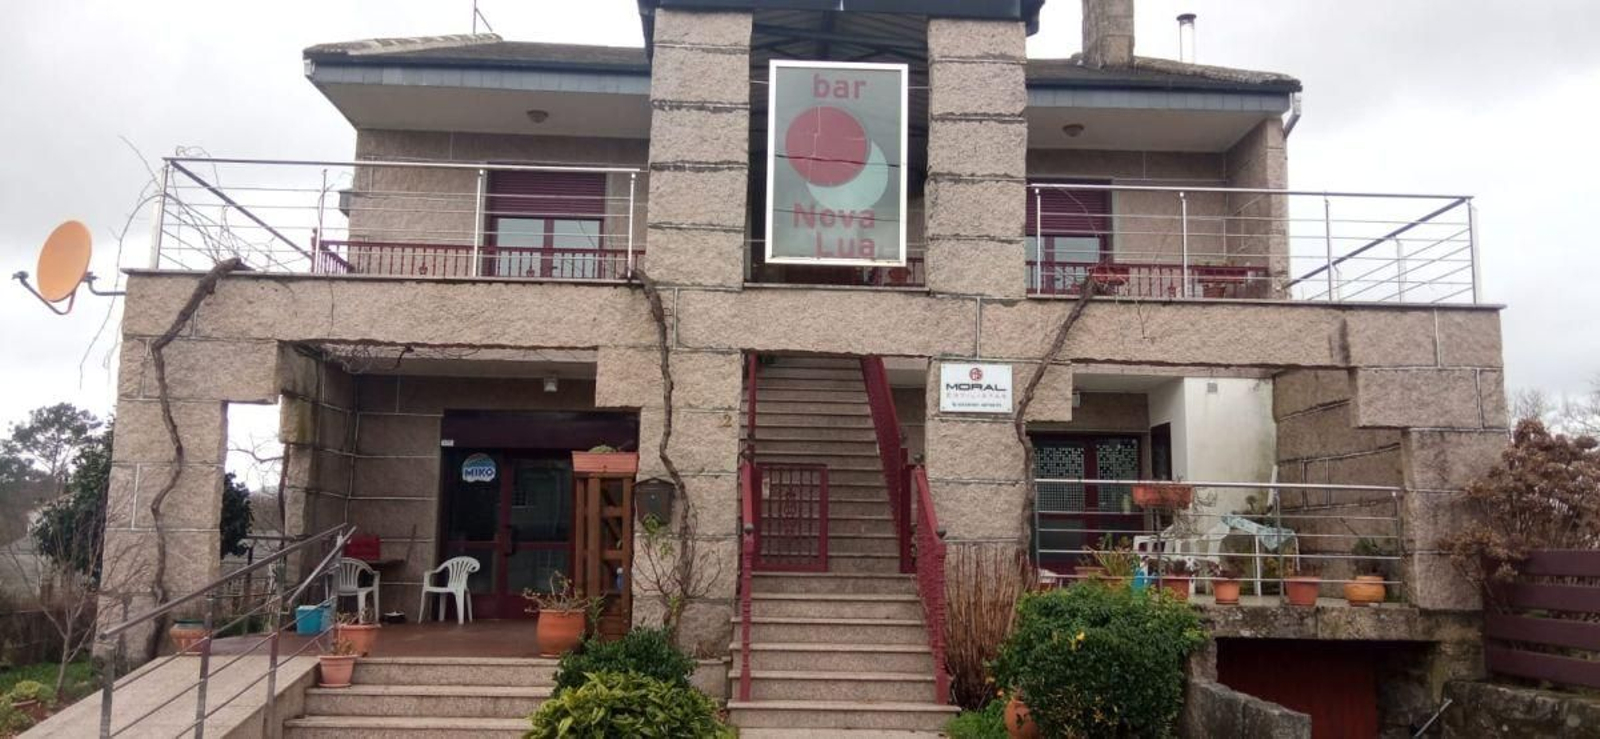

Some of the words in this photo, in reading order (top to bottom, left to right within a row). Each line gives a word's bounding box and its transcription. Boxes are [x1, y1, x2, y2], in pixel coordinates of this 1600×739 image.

[813, 73, 867, 99] bar
[793, 202, 876, 230] Nova
[815, 231, 876, 259] Lua
[945, 383, 1008, 392] MORAL
[722, 414, 733, 428] 2
[464, 467, 494, 478] MIKO
